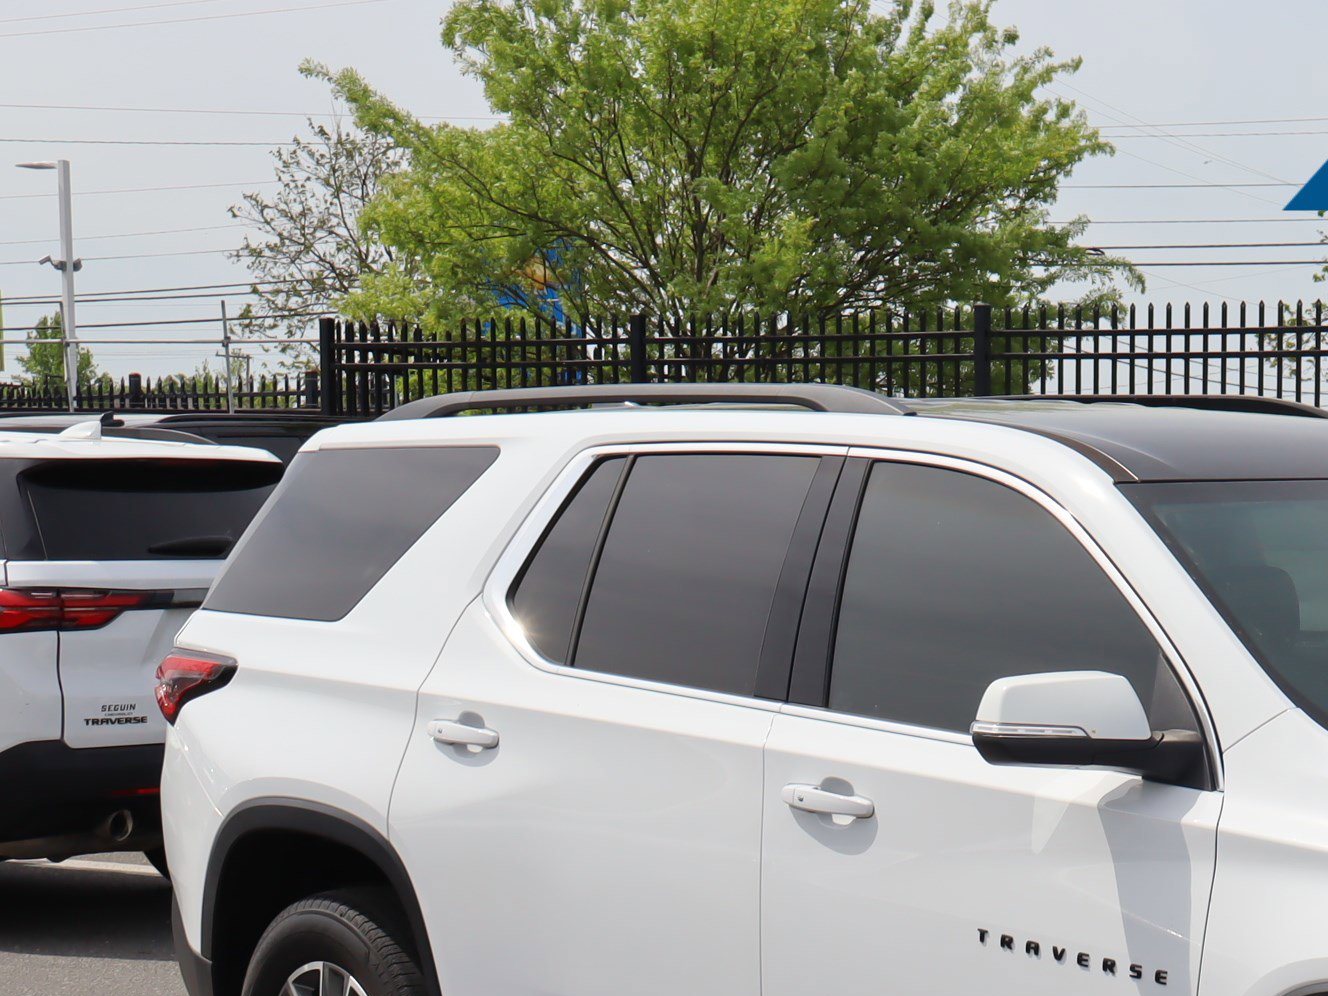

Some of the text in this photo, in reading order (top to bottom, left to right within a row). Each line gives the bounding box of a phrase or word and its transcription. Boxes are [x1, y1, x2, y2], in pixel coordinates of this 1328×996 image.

[101, 703, 136, 712] SEGUIN
[84, 716, 148, 726] TRAVERSE
[977, 928, 1168, 986] TRAVERSE
